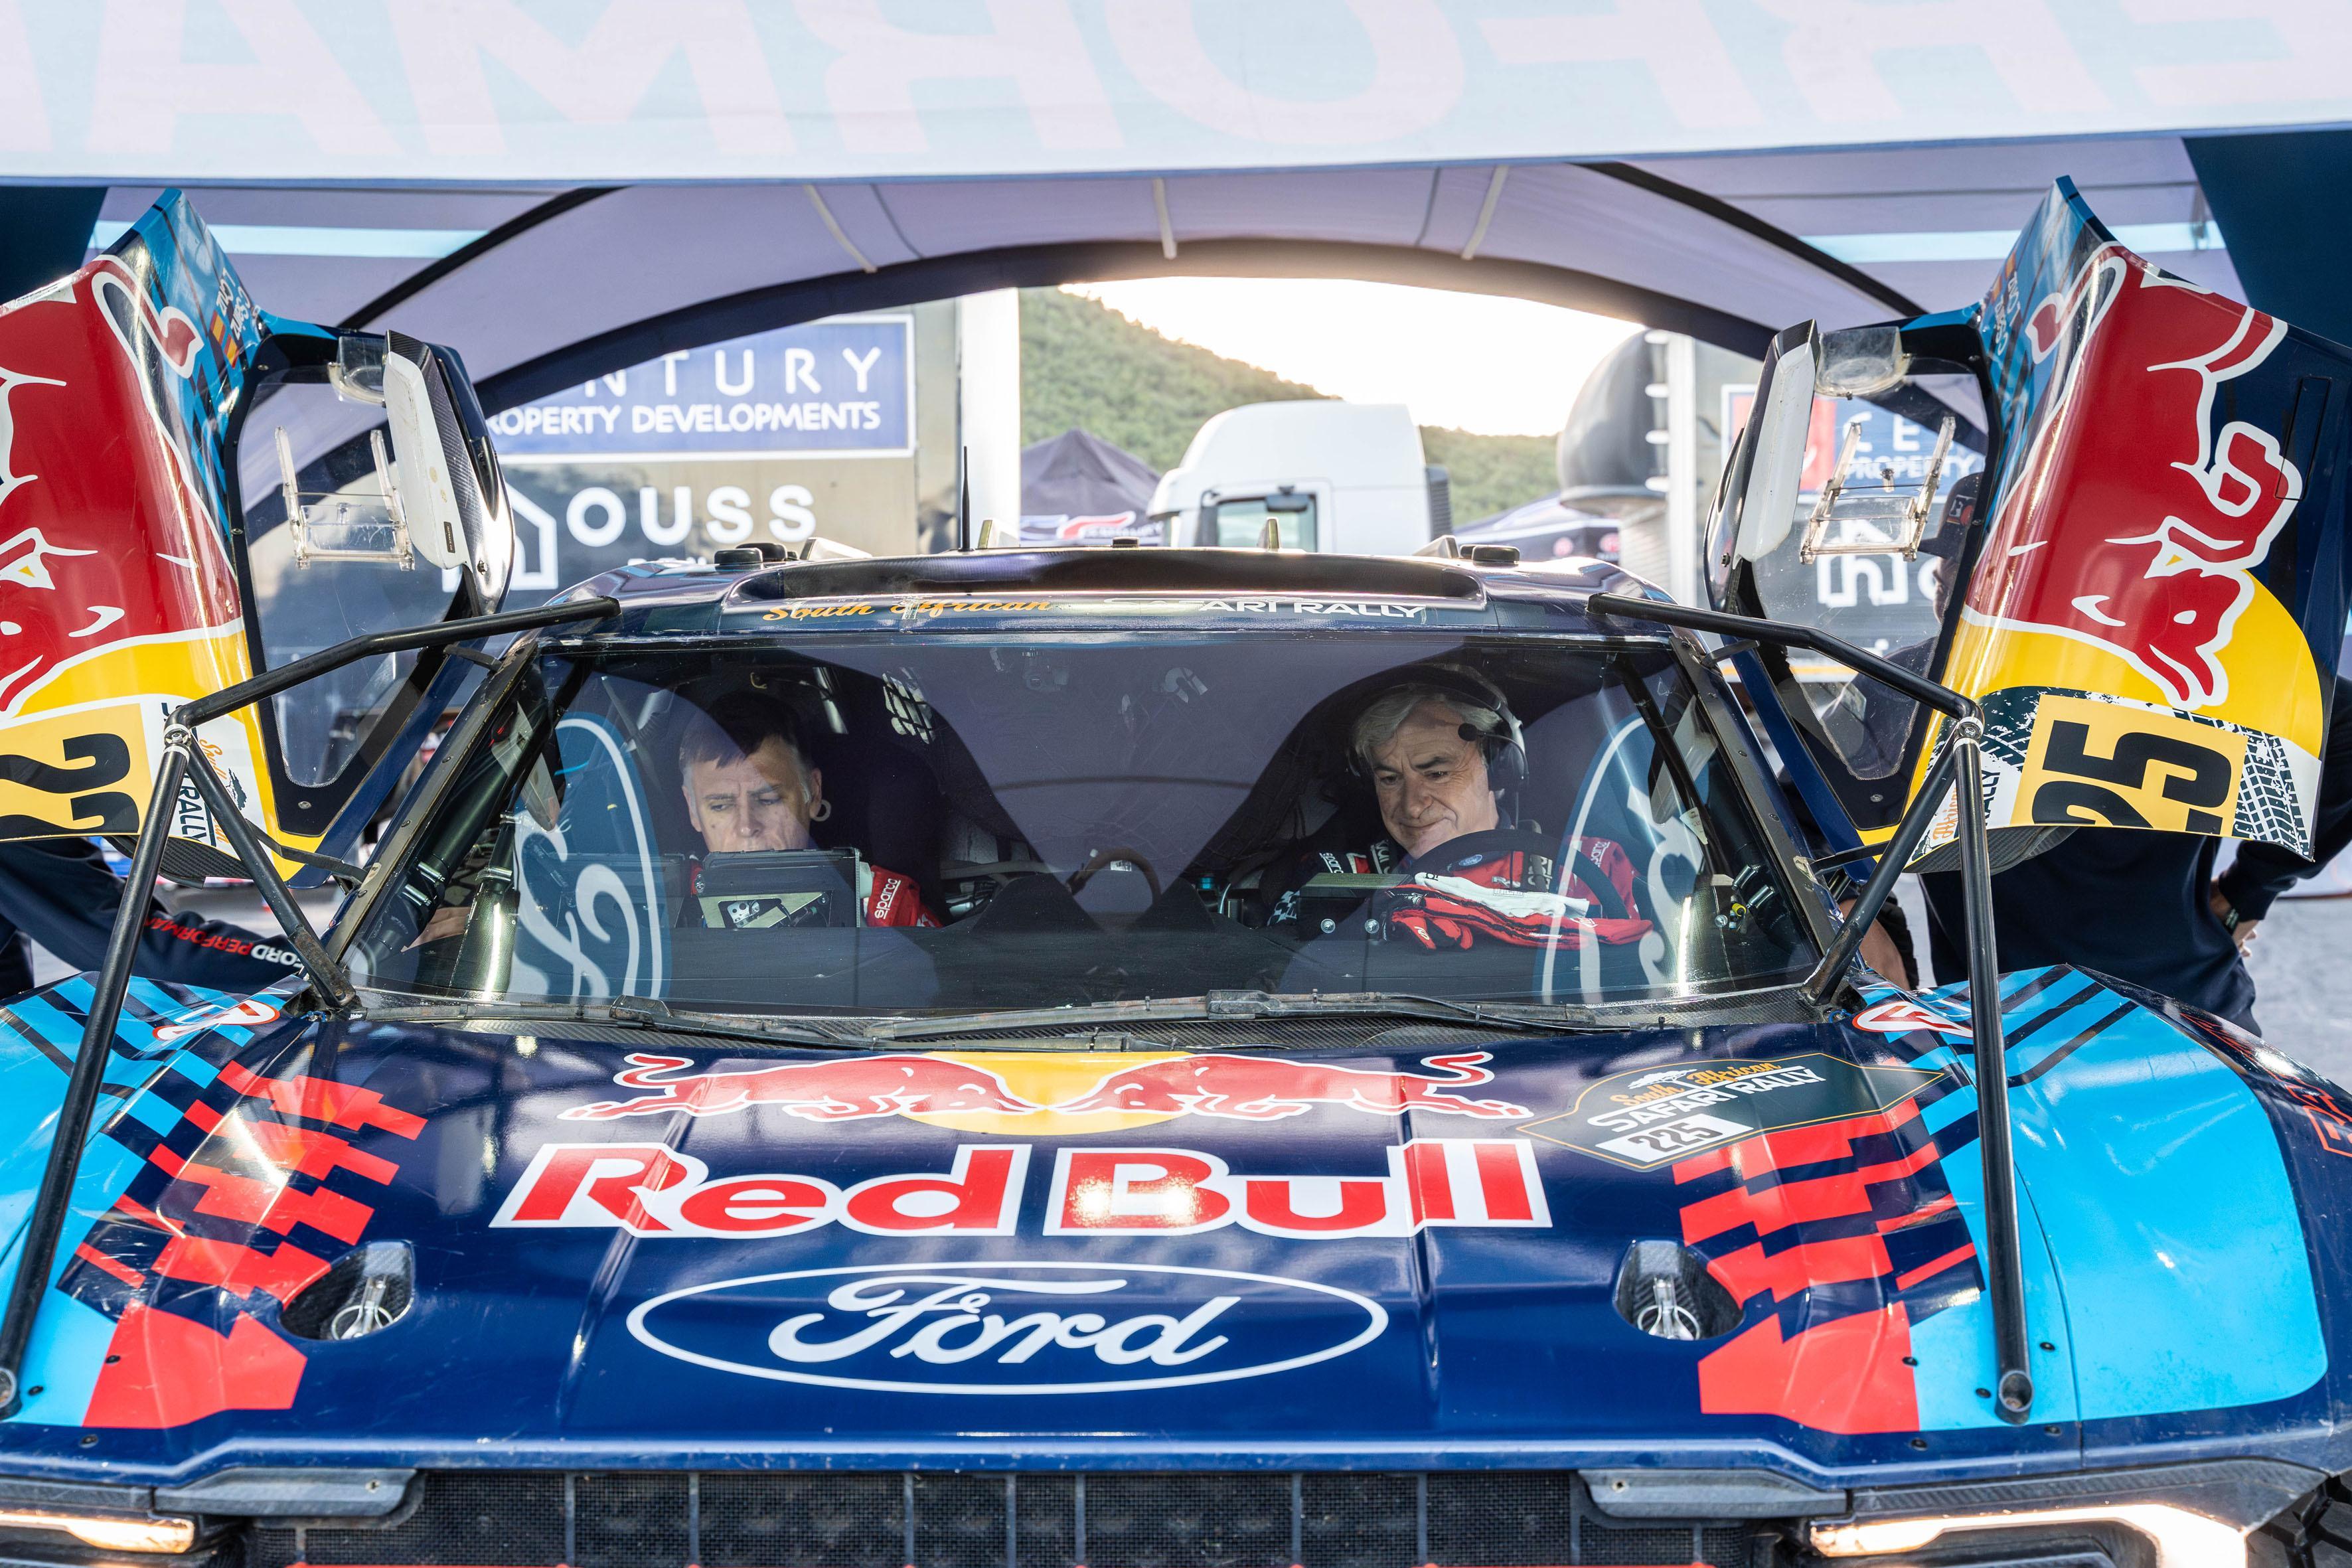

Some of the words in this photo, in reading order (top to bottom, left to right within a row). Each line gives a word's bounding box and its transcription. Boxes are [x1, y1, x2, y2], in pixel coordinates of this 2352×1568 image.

[485, 404, 621, 436] OPERTY
[631, 402, 882, 433] DEVELOPMENTS
[1294, 601, 1426, 618] RALLY
[874, 878, 901, 919] sparco
[1587, 1087, 1738, 1133] SAFARI
[1725, 1067, 1826, 1094] RALLY
[1610, 1083, 1686, 1107] South
[1686, 1061, 1783, 1085] African
[1627, 1122, 1724, 1152] 225
[489, 1141, 1033, 1239] Red
[1044, 1137, 1552, 1240] Bull
[767, 1273, 1241, 1368] Ford
